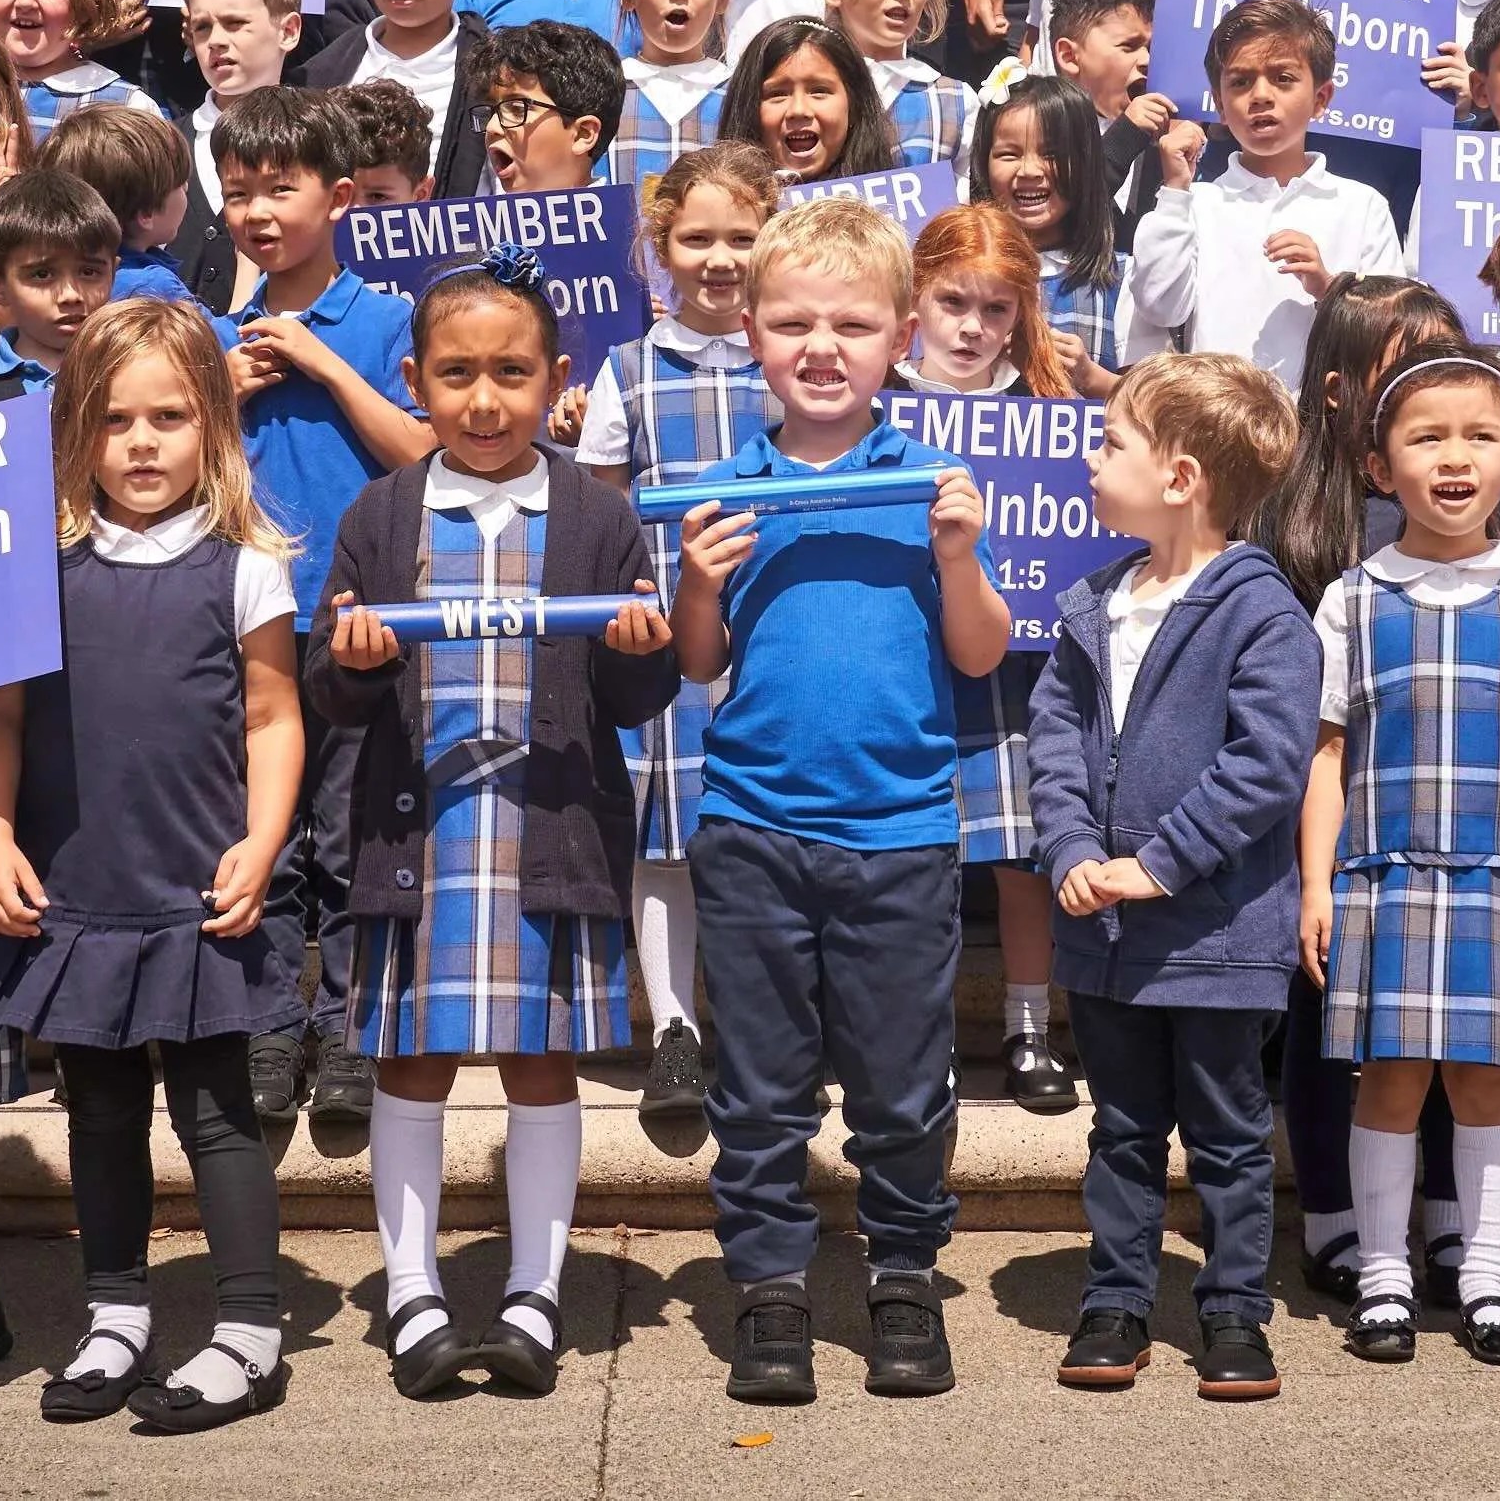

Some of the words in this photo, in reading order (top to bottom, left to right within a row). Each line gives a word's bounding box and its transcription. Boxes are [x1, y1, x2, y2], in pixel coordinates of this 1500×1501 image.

[350, 192, 608, 262] REMEMBER
[998, 559, 1047, 591] 1:5
[440, 596, 550, 639] WEST
